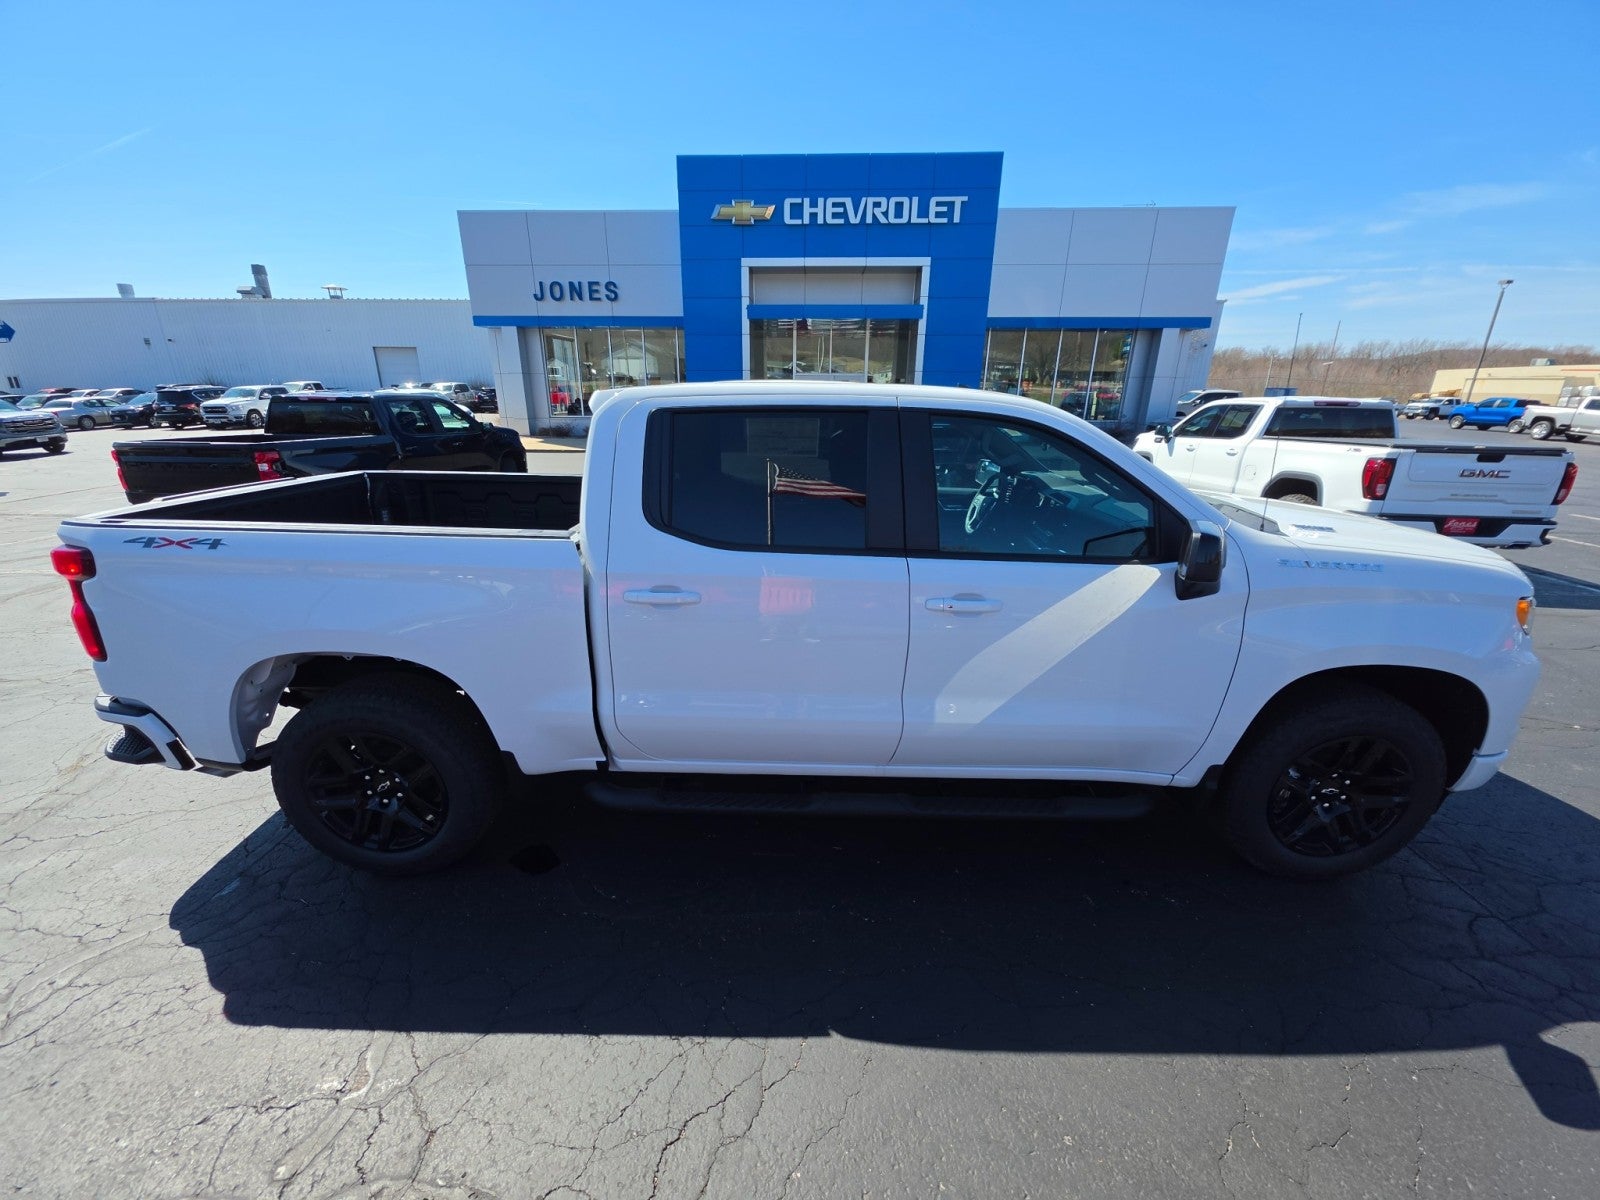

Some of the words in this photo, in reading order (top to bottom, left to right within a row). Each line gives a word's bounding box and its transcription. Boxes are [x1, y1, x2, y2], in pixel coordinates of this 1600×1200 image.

[783, 195, 969, 225] CHEVROLET
[533, 280, 619, 302] JONES
[1459, 468, 1511, 479] GMC
